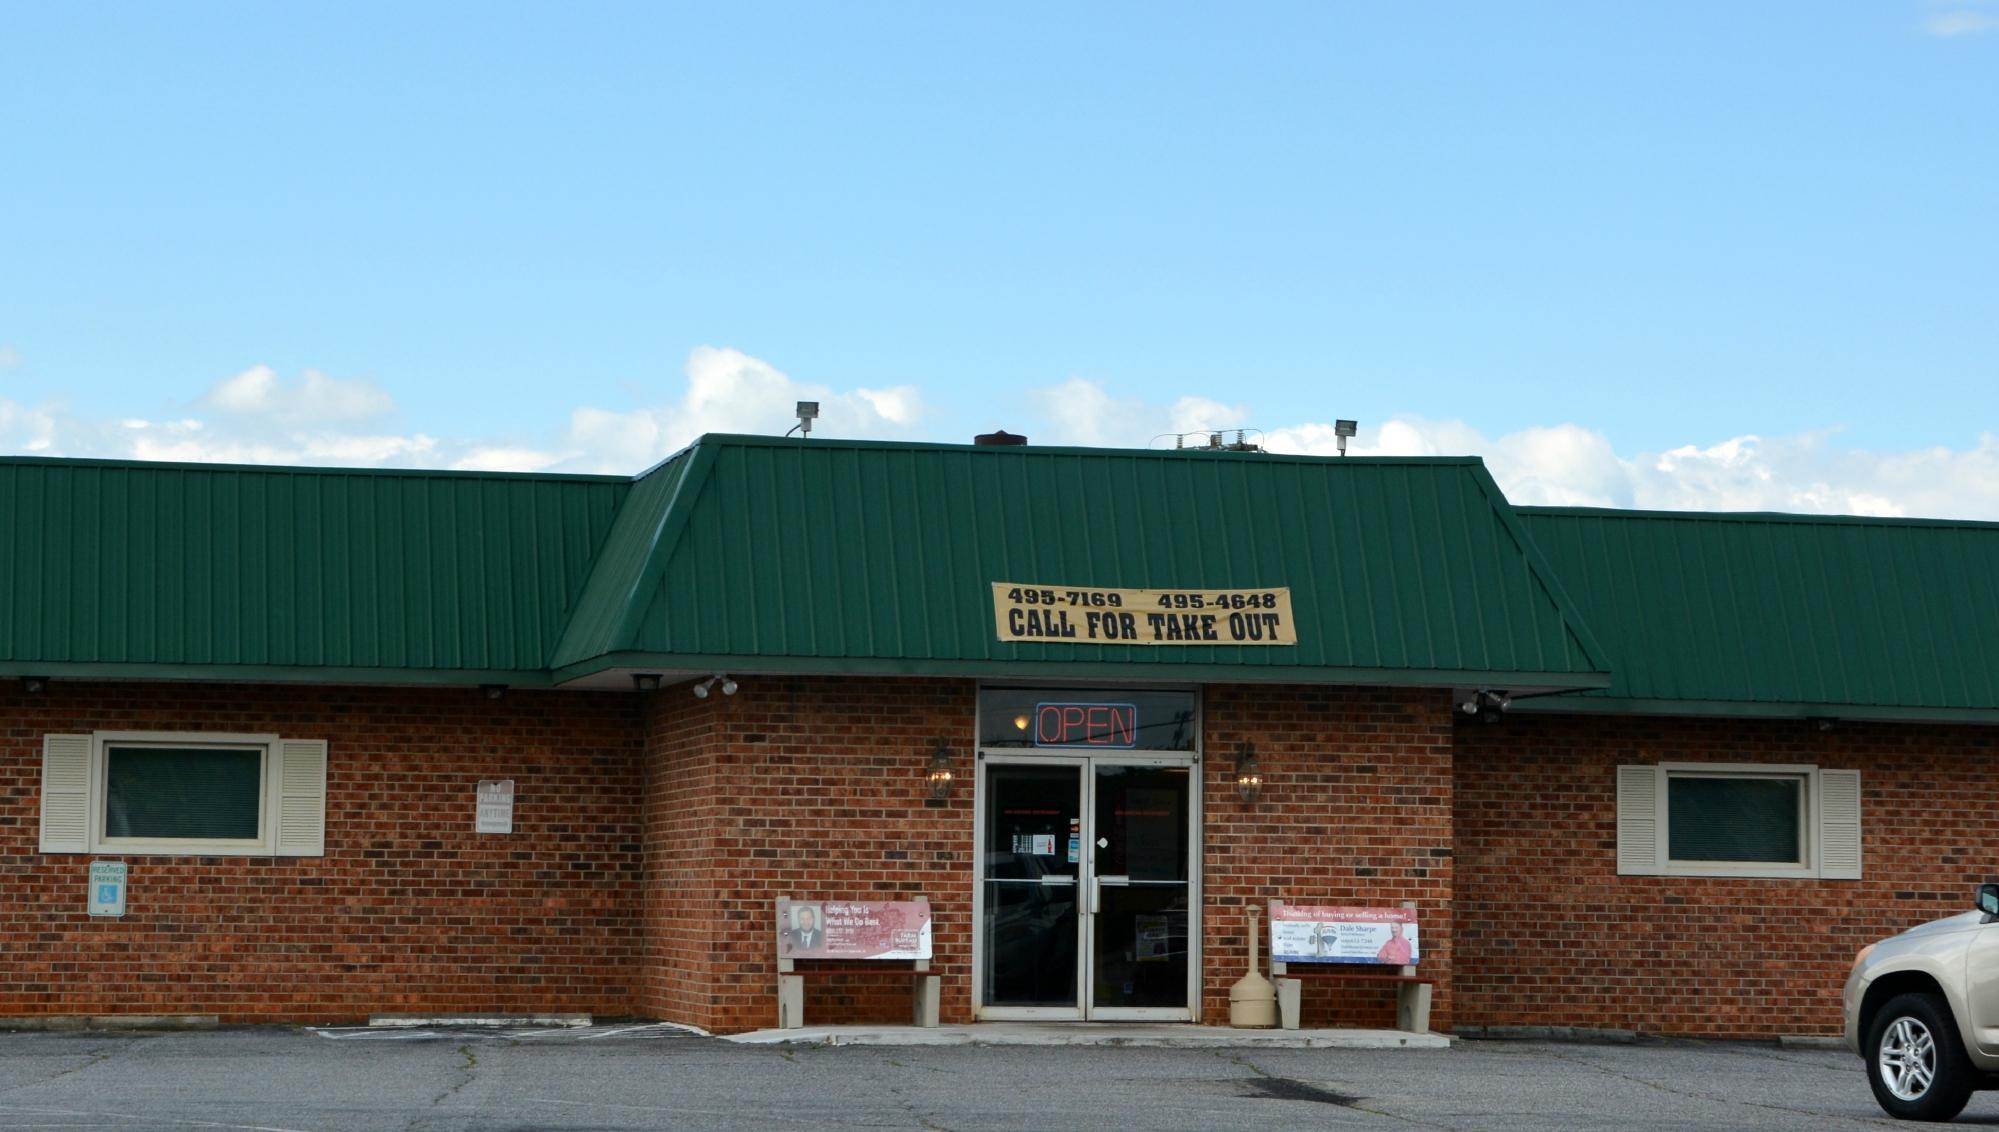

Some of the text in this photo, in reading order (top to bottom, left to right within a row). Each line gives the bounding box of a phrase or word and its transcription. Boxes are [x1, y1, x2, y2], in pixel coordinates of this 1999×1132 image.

[1008, 588, 1122, 607] 495-7169
[1158, 593, 1276, 609] 495-4648
[1009, 608, 1280, 641] CALL FOR TAKE OUT
[1039, 706, 1133, 744] OPEN
[490, 783, 500, 792] NO
[479, 792, 512, 801] PARKING
[480, 807, 512, 818] ANYTIME
[1283, 910, 1312, 919] Thinking
[1313, 910, 1321, 918] of
[1321, 910, 1345, 920] buying
[1355, 911, 1378, 920] selling
[826, 916, 842, 926] What
[1355, 925, 1377, 934] Sharpe
